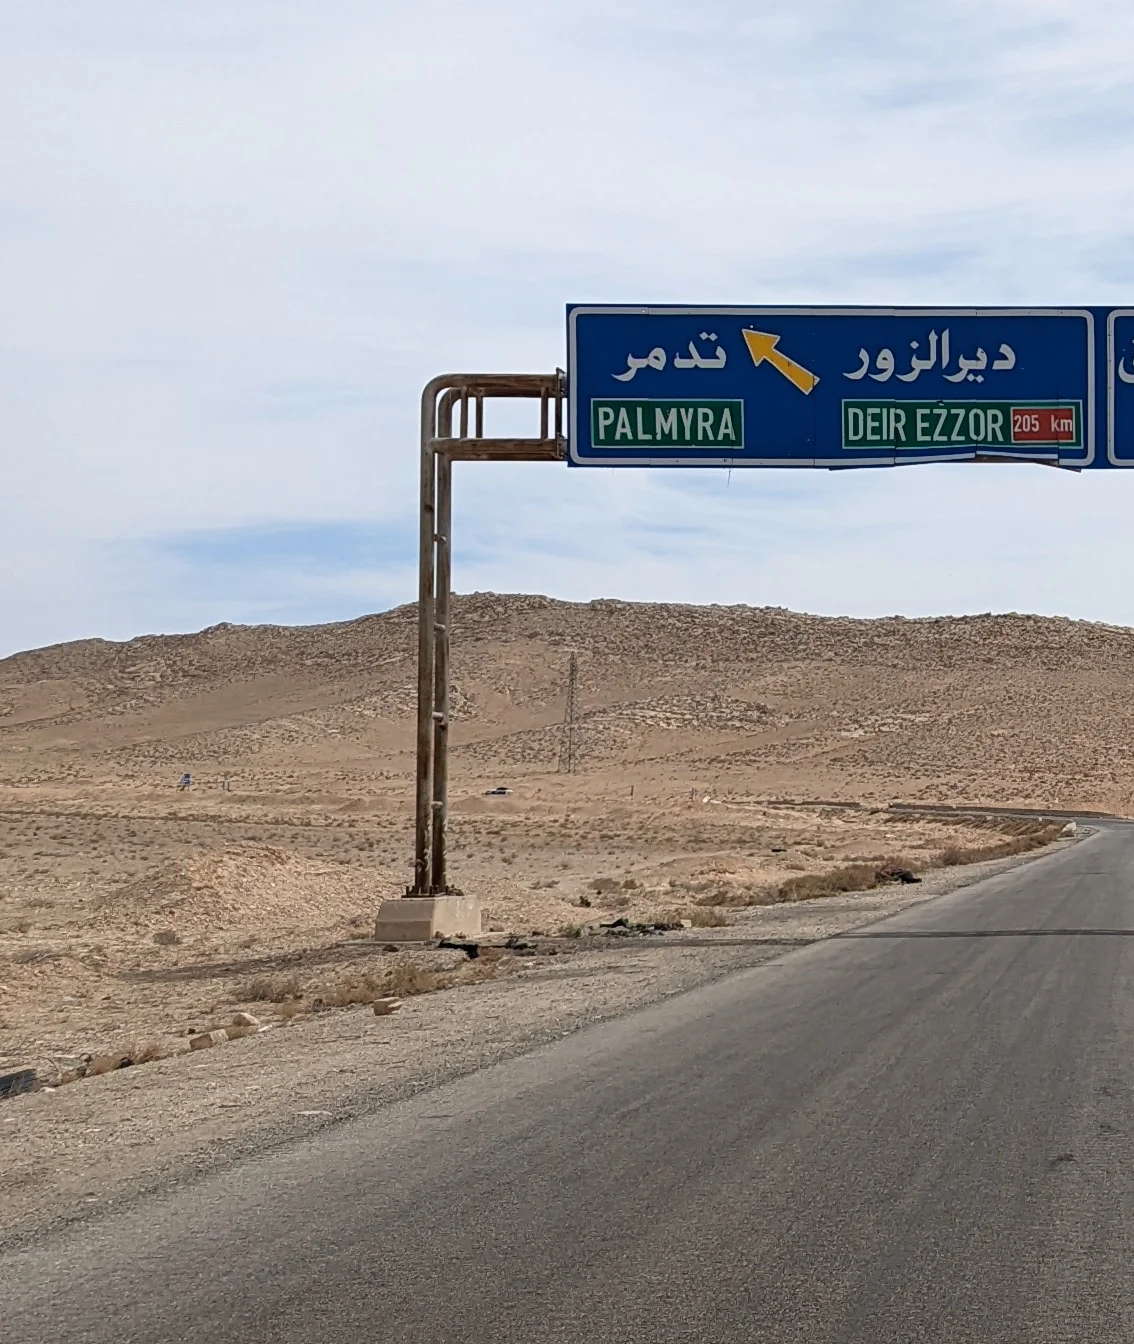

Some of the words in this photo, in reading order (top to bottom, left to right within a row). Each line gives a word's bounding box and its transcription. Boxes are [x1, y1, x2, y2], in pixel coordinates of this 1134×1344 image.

[612, 332, 727, 381] تدمر
[598, 407, 734, 441] PALMYRA
[848, 407, 905, 441] DEIR
[916, 408, 1003, 442] EZZOR
[1013, 414, 1040, 433] 205
[1051, 414, 1074, 432] km
